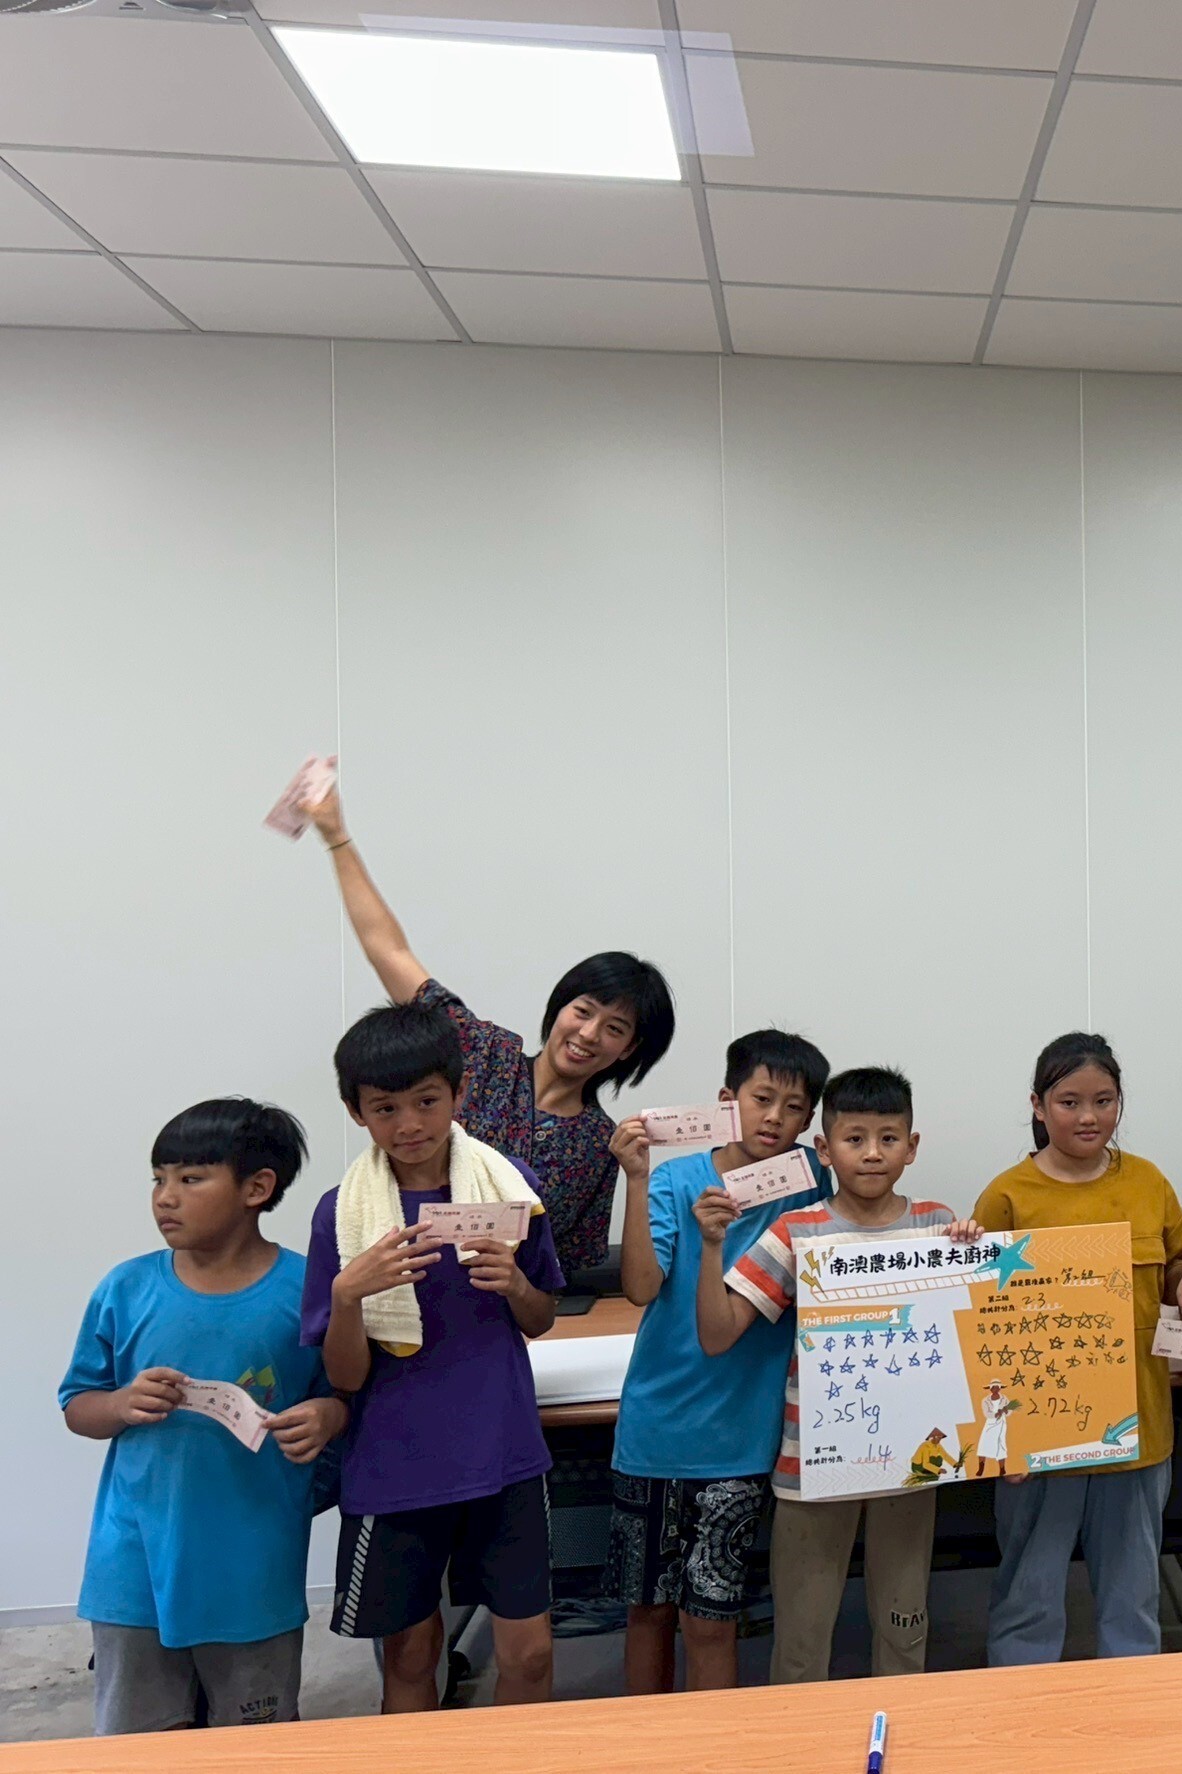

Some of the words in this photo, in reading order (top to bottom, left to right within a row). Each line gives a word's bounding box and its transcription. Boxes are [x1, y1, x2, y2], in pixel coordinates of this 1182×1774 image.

[830, 1245, 1001, 1277] 南澳農場小農夫廚神
[802, 1317, 822, 1327] THE
[824, 1314, 852, 1325] FIRST
[853, 1311, 888, 1321] GROUP
[1043, 1455, 1061, 1464] THE
[1063, 1450, 1101, 1461] SECOND
